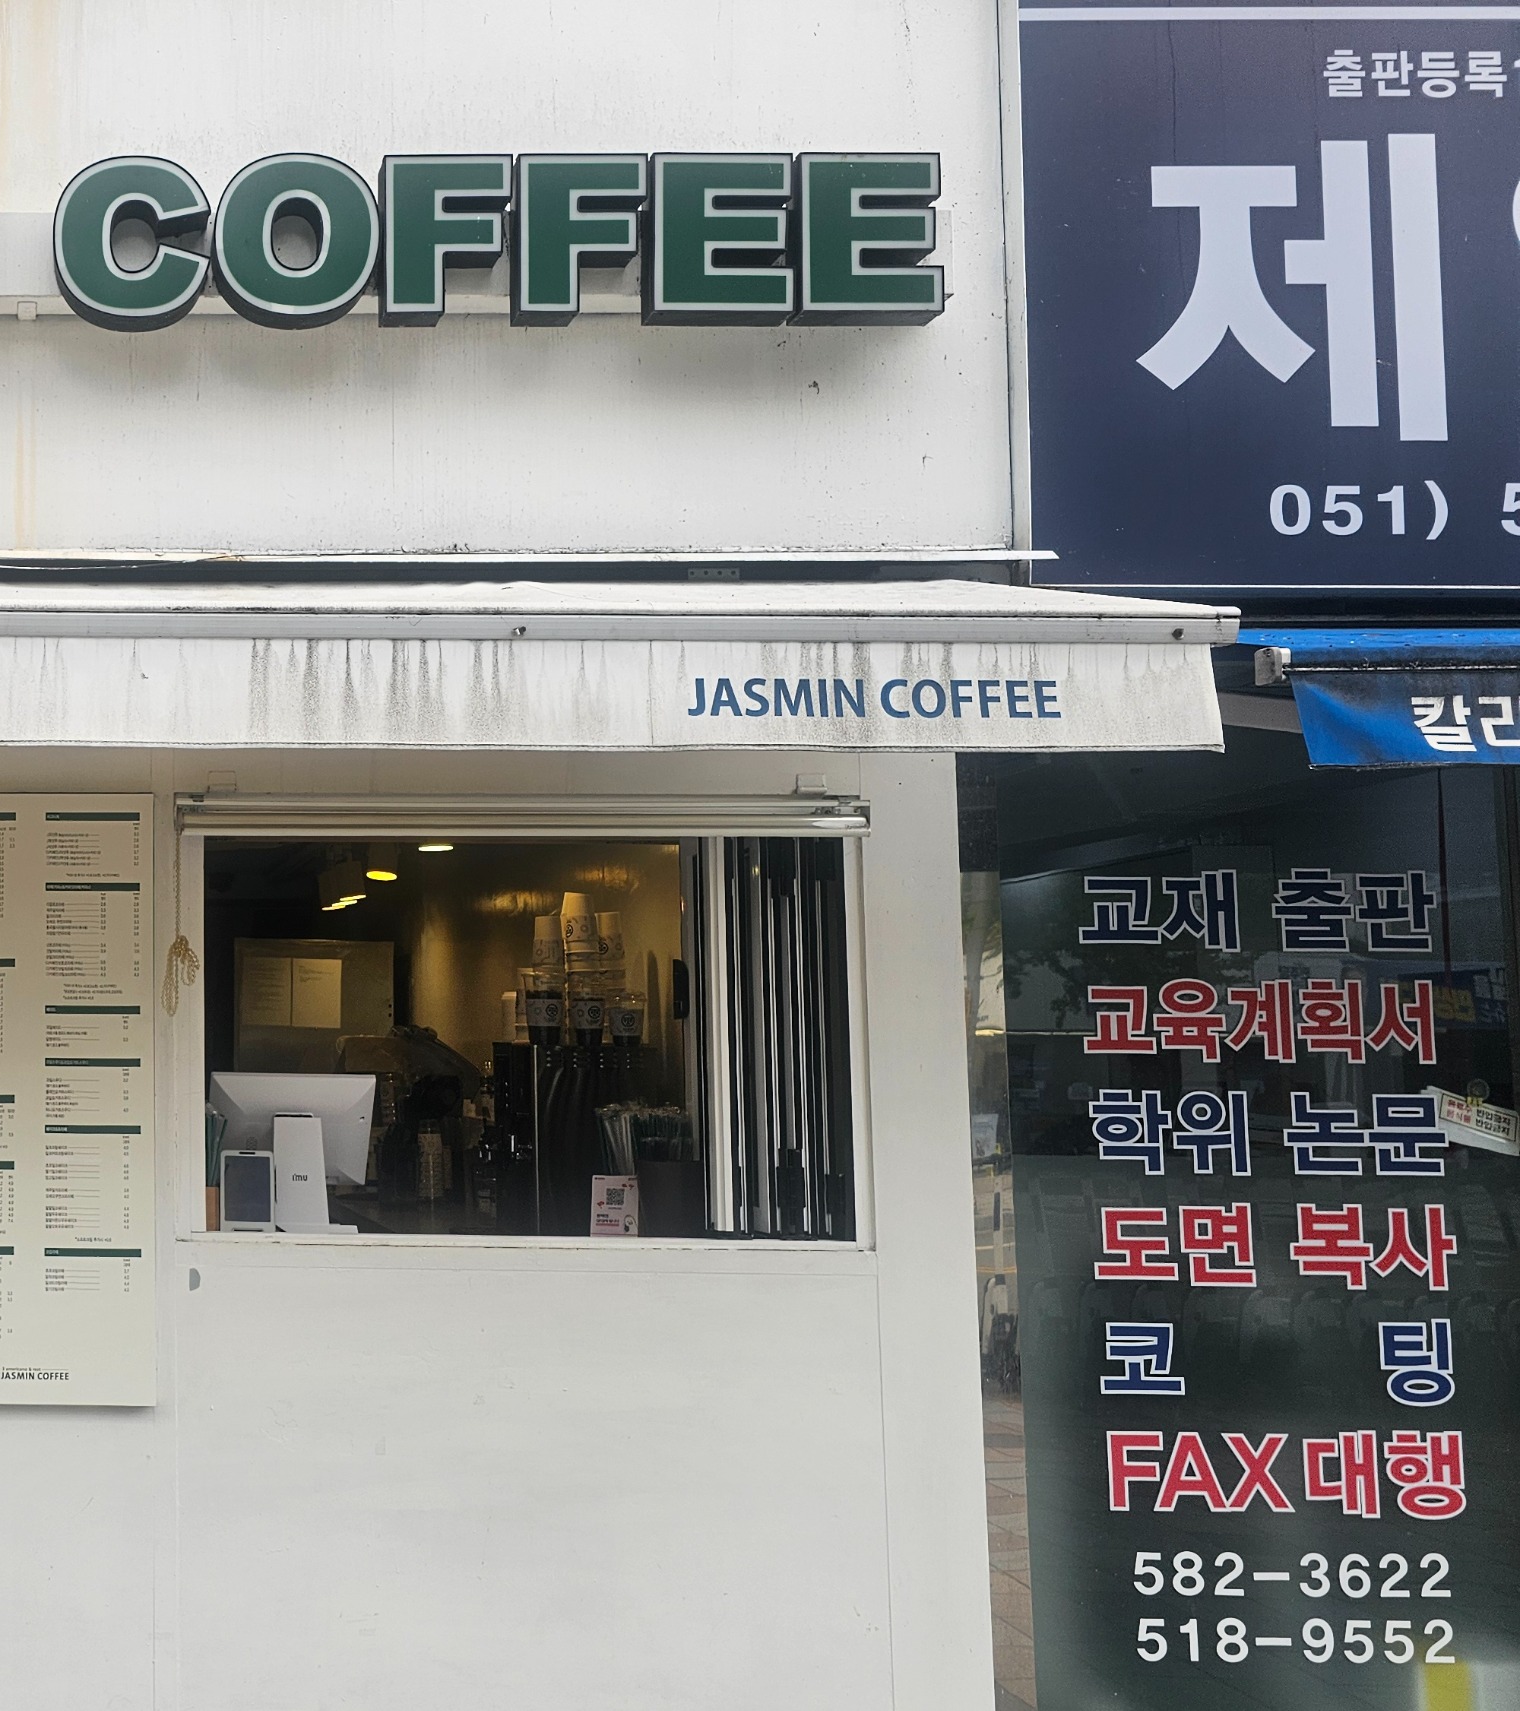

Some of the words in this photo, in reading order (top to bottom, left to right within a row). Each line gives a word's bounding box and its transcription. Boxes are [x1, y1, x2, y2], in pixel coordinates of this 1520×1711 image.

[1323, 50, 1520, 98] 출판등록
[52, 152, 946, 330] COFFEE
[1136, 133, 1520, 441] 제
[1269, 480, 1449, 540] 051)
[688, 678, 866, 718] JASMIN
[880, 680, 1062, 718] COFFEE
[1079, 869, 1241, 953] 교재
[1272, 868, 1436, 952] 출판
[1084, 978, 1437, 1064] 교육계획서
[1089, 1089, 1252, 1176] 학위
[1284, 1092, 1449, 1176] 논문
[1094, 1202, 1257, 1287] 도면
[1290, 1203, 1457, 1290] 복사
[1, 1371, 35, 1380] JASMIN
[37, 1372, 70, 1381] COFFEE
[1106, 1431, 1295, 1512] FAX
[1303, 1431, 1466, 1520] 대행
[1133, 1551, 1452, 1598] 582-3622
[1136, 1618, 1456, 1664] 518-9552
